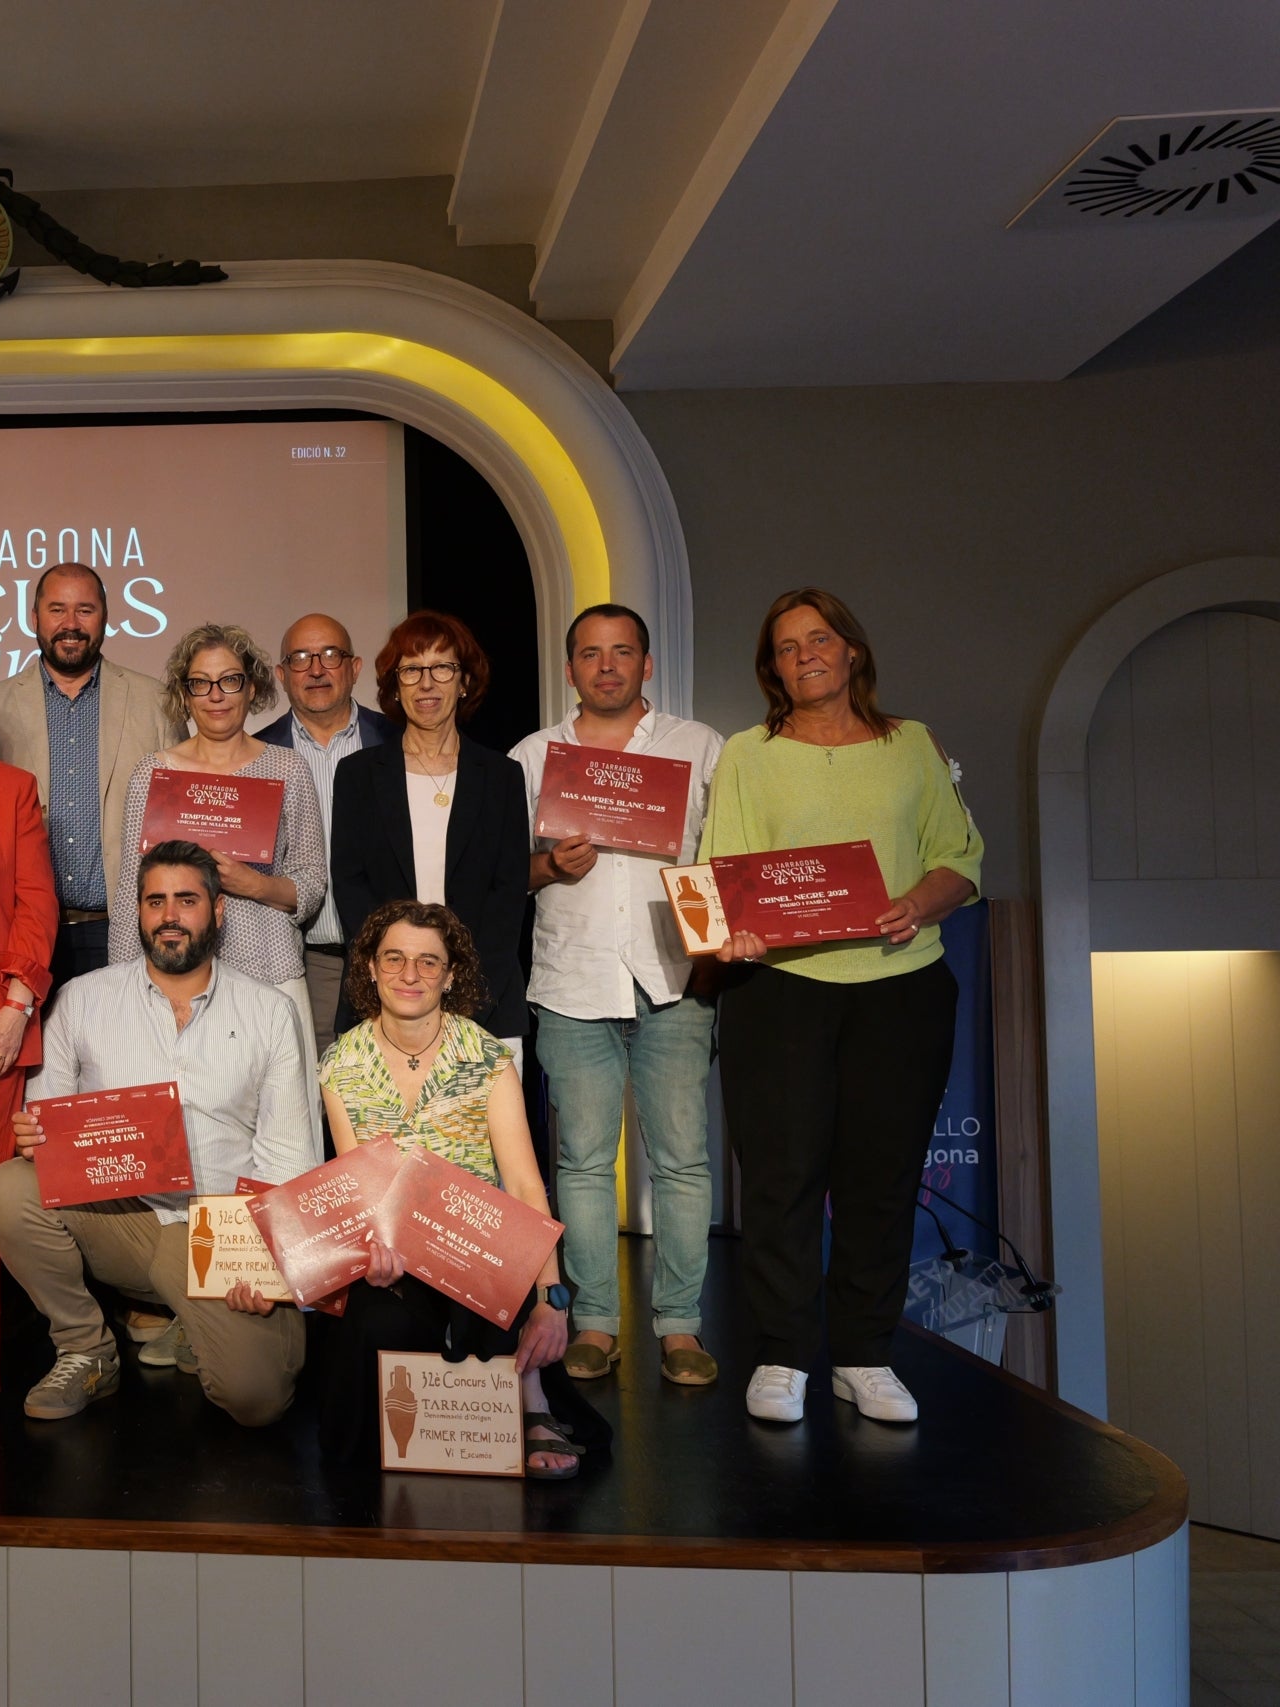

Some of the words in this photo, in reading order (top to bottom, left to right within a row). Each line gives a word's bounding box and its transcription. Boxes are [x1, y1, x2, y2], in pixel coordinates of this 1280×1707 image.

[292, 445, 320, 458] EDICIÓ
[324, 447, 333, 458] N.
[336, 447, 346, 457] 32
[602, 762, 641, 774] TARRAGONA
[585, 767, 643, 784] CONCURS
[202, 785, 237, 793] TARRAGONA
[594, 778, 607, 786] de
[610, 780, 630, 789] vins
[186, 789, 239, 801] CONCURS
[561, 792, 579, 800] MAS
[581, 795, 614, 805] AMFRES
[616, 800, 644, 810] BLANC
[647, 804, 665, 812] 2025
[208, 799, 227, 807] vins
[180, 812, 222, 822] TEMPTACIÓ
[776, 859, 820, 868] TARRAGONA
[761, 865, 826, 879] CONCURS
[774, 876, 788, 885] de
[792, 875, 814, 884] vins
[758, 896, 791, 905] CRINEL
[794, 892, 824, 900] NEGRE
[827, 889, 848, 897] 2025
[124, 1132, 145, 1141] L'AVI
[97, 1156, 118, 1166] vins
[121, 1153, 135, 1165] de
[85, 1161, 146, 1178] CONCURS
[135, 1172, 144, 1180] DO
[91, 1172, 132, 1185] TARRAGONA
[297, 1194, 309, 1202] DO
[309, 1173, 351, 1197] TARRAGONA
[299, 1178, 359, 1213] CONCURS
[449, 1183, 458, 1193] DO
[461, 1190, 503, 1218] TARRAGONA
[315, 1204, 328, 1217] de
[330, 1194, 351, 1209] vins
[440, 1190, 502, 1230] CONCURS
[445, 1205, 461, 1218] de
[462, 1213, 485, 1230] vins
[282, 1222, 339, 1258] CHARDONNAY
[342, 1217, 354, 1228] DE
[334, 1233, 343, 1241] DE
[344, 1222, 366, 1235] MULLER
[218, 1235, 262, 1244] TARRAG
[412, 1211, 431, 1226] SYH
[431, 1221, 444, 1233] DE
[445, 1228, 481, 1254] MULLER
[482, 1249, 503, 1267] 2023
[436, 1235, 446, 1243] DE
[447, 1240, 470, 1257] MULLER
[215, 1262, 242, 1271] PRIMER
[246, 1262, 269, 1271] PREMI
[443, 1371, 486, 1388] Concurs
[491, 1372, 513, 1391] Vins
[422, 1398, 514, 1413] TARRAGONA
[420, 1429, 456, 1442] PRIMER
[460, 1431, 491, 1443] PREMI
[494, 1432, 517, 1443] 2026
[445, 1448, 454, 1458] Vi
